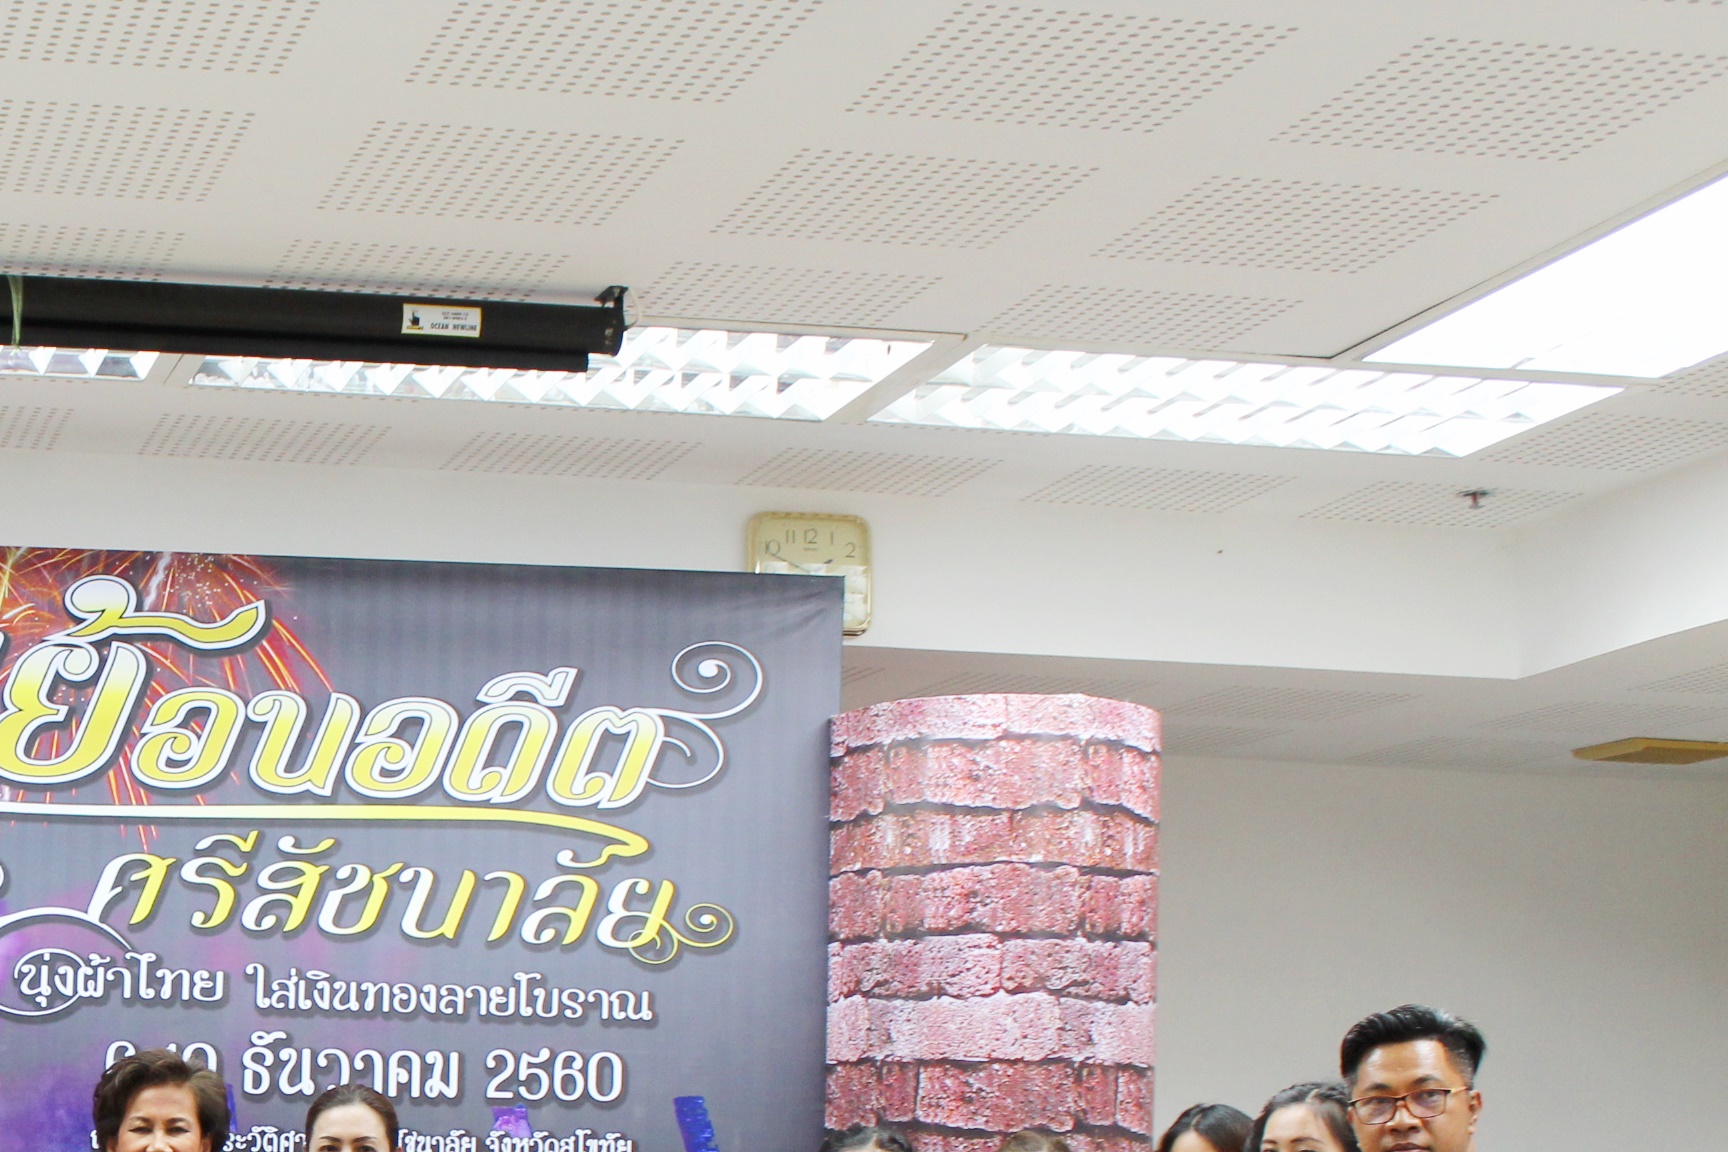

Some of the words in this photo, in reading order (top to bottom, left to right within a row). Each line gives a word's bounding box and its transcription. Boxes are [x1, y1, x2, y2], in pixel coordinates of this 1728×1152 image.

[765, 539, 781, 556] 10
[804, 528, 818, 544] 12
[845, 542, 856, 558] 2
[87, 829, 677, 953] ศรีสัชนาลัย
[19, 952, 225, 1008] นุ่งผ้าไทย
[245, 962, 654, 1021] ใส่เงินทองลายโบราณ
[241, 1031, 460, 1099] ธันวาคม
[484, 1047, 625, 1102] 2560
